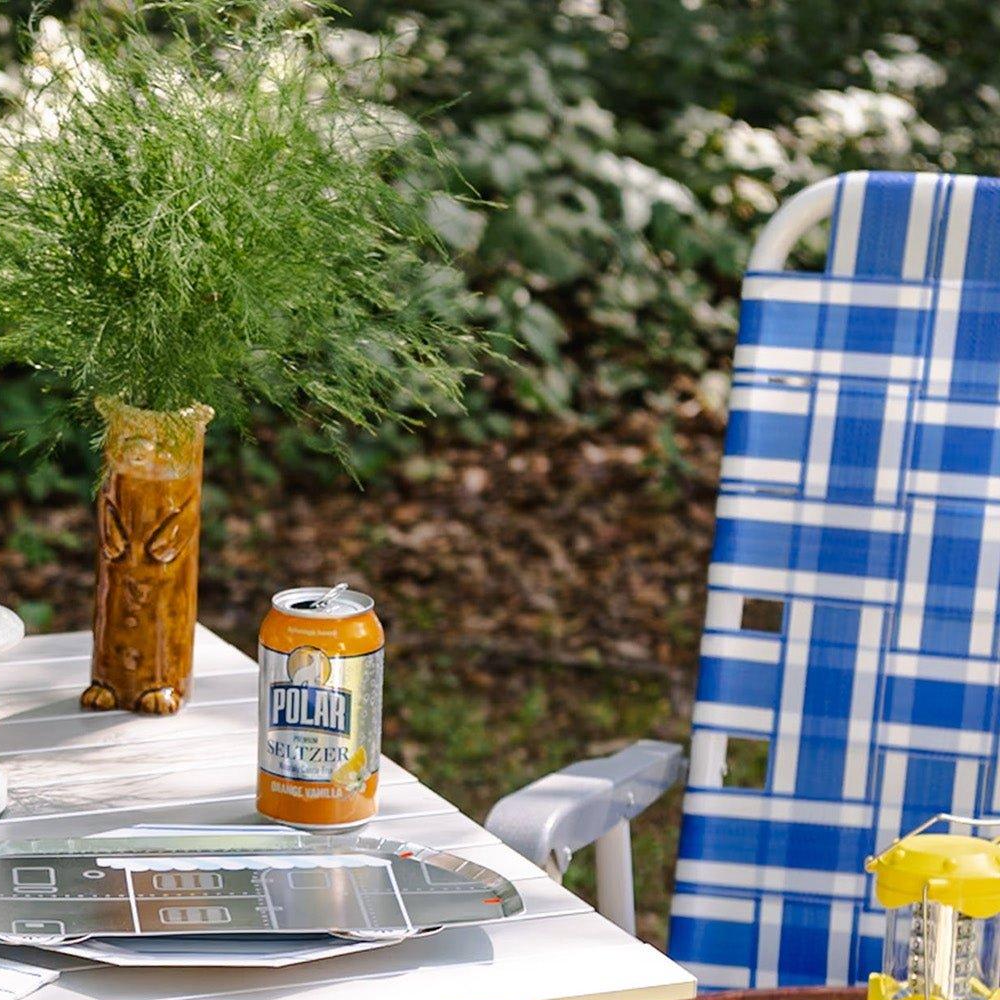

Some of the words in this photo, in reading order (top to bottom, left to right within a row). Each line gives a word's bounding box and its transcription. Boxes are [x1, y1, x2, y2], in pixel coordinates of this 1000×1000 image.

[273, 688, 346, 731] POLAR
[267, 740, 349, 762] SELTZER
[271, 781, 304, 797] ORANGE
[305, 786, 343, 799] VANILLA
